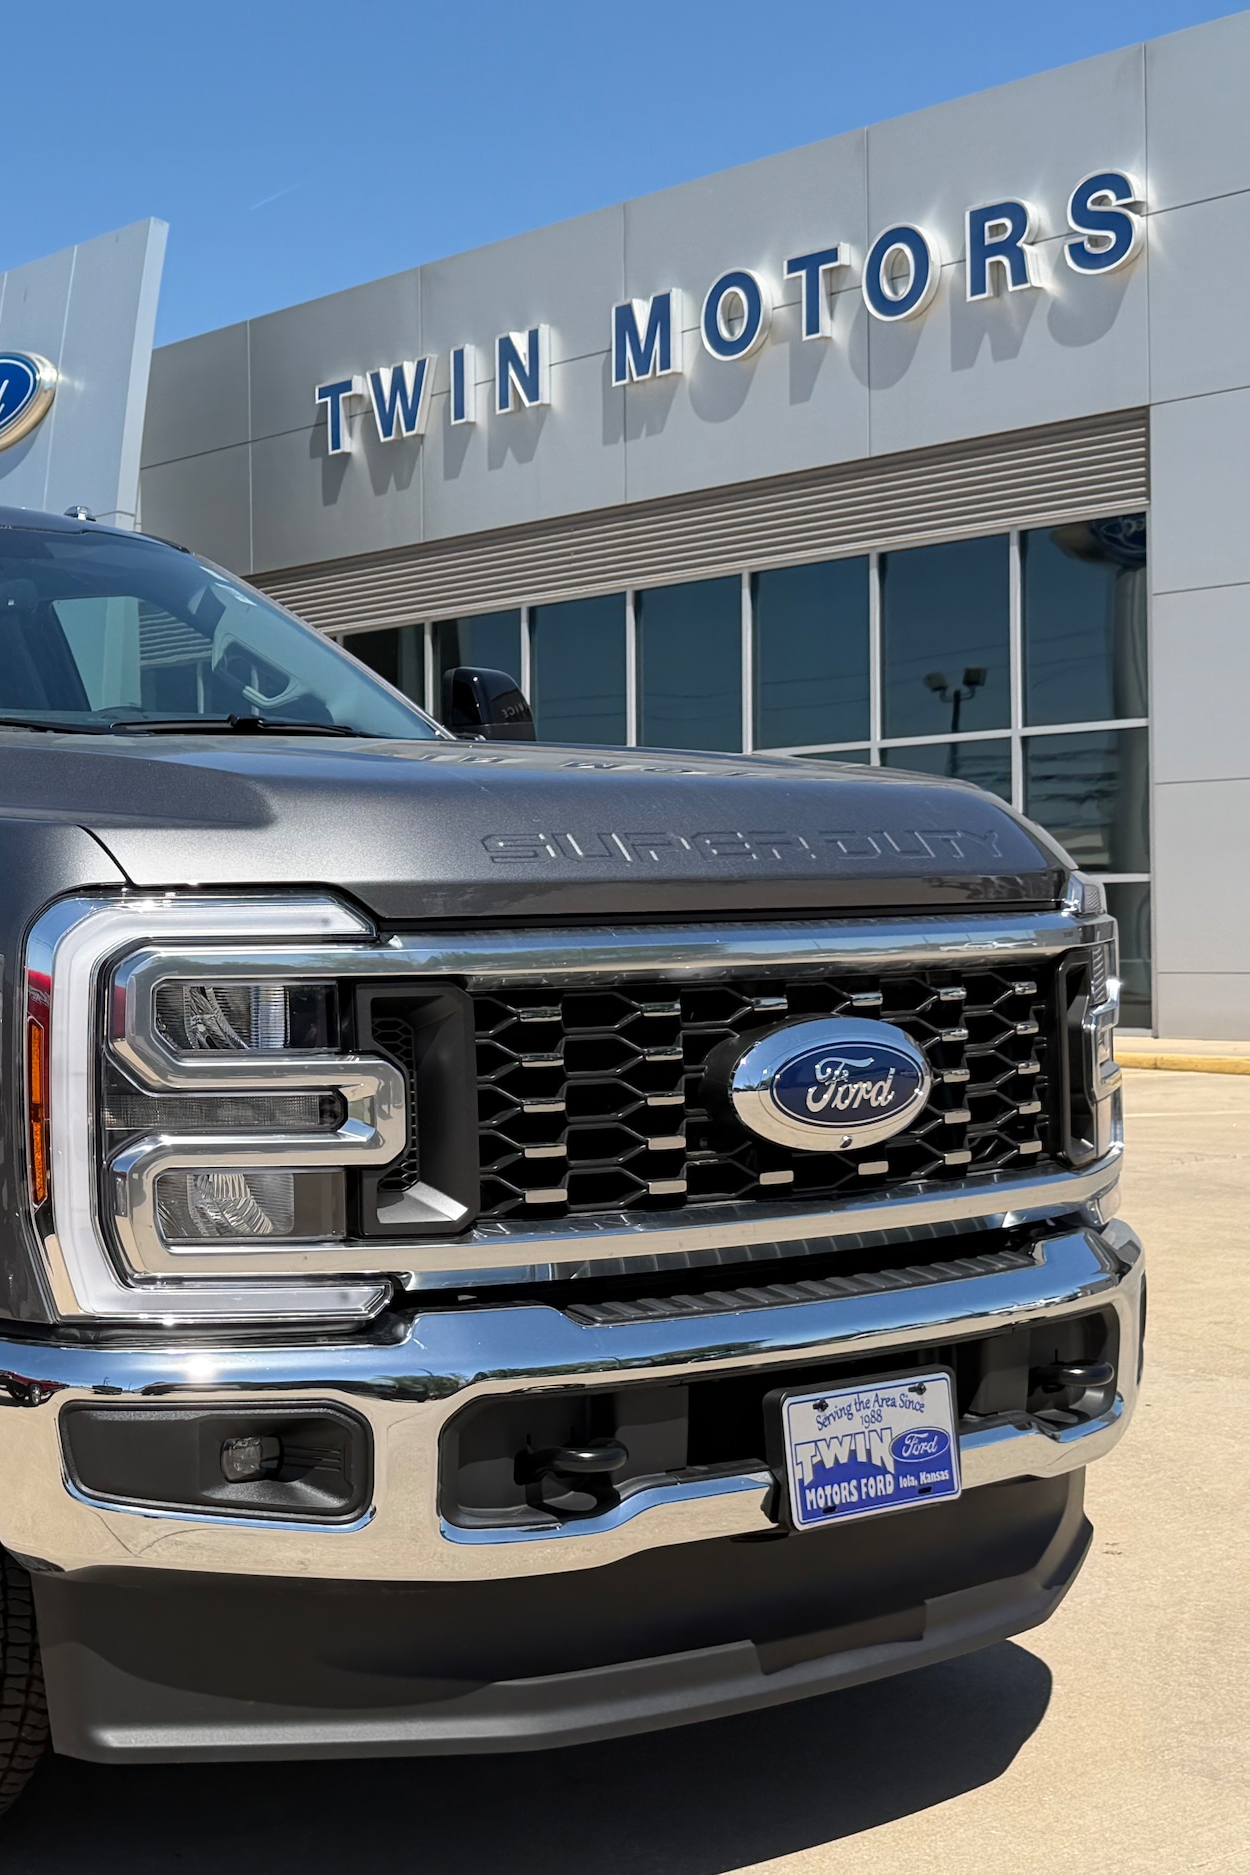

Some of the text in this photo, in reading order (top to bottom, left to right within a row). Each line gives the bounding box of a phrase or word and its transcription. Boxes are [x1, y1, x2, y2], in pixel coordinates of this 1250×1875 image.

[315, 168, 1145, 456] TWIN MOTORS
[480, 829, 1003, 863] SUPER DUTY
[806, 1057, 896, 1113] Ford
[816, 1392, 925, 1431] Serving the Area Since
[860, 1408, 883, 1429] 1988
[794, 1426, 895, 1487] TWIN
[901, 1432, 938, 1458] Ford
[805, 1473, 895, 1511] MOTORS FORD
[899, 1469, 950, 1489] Iola, Kansas
